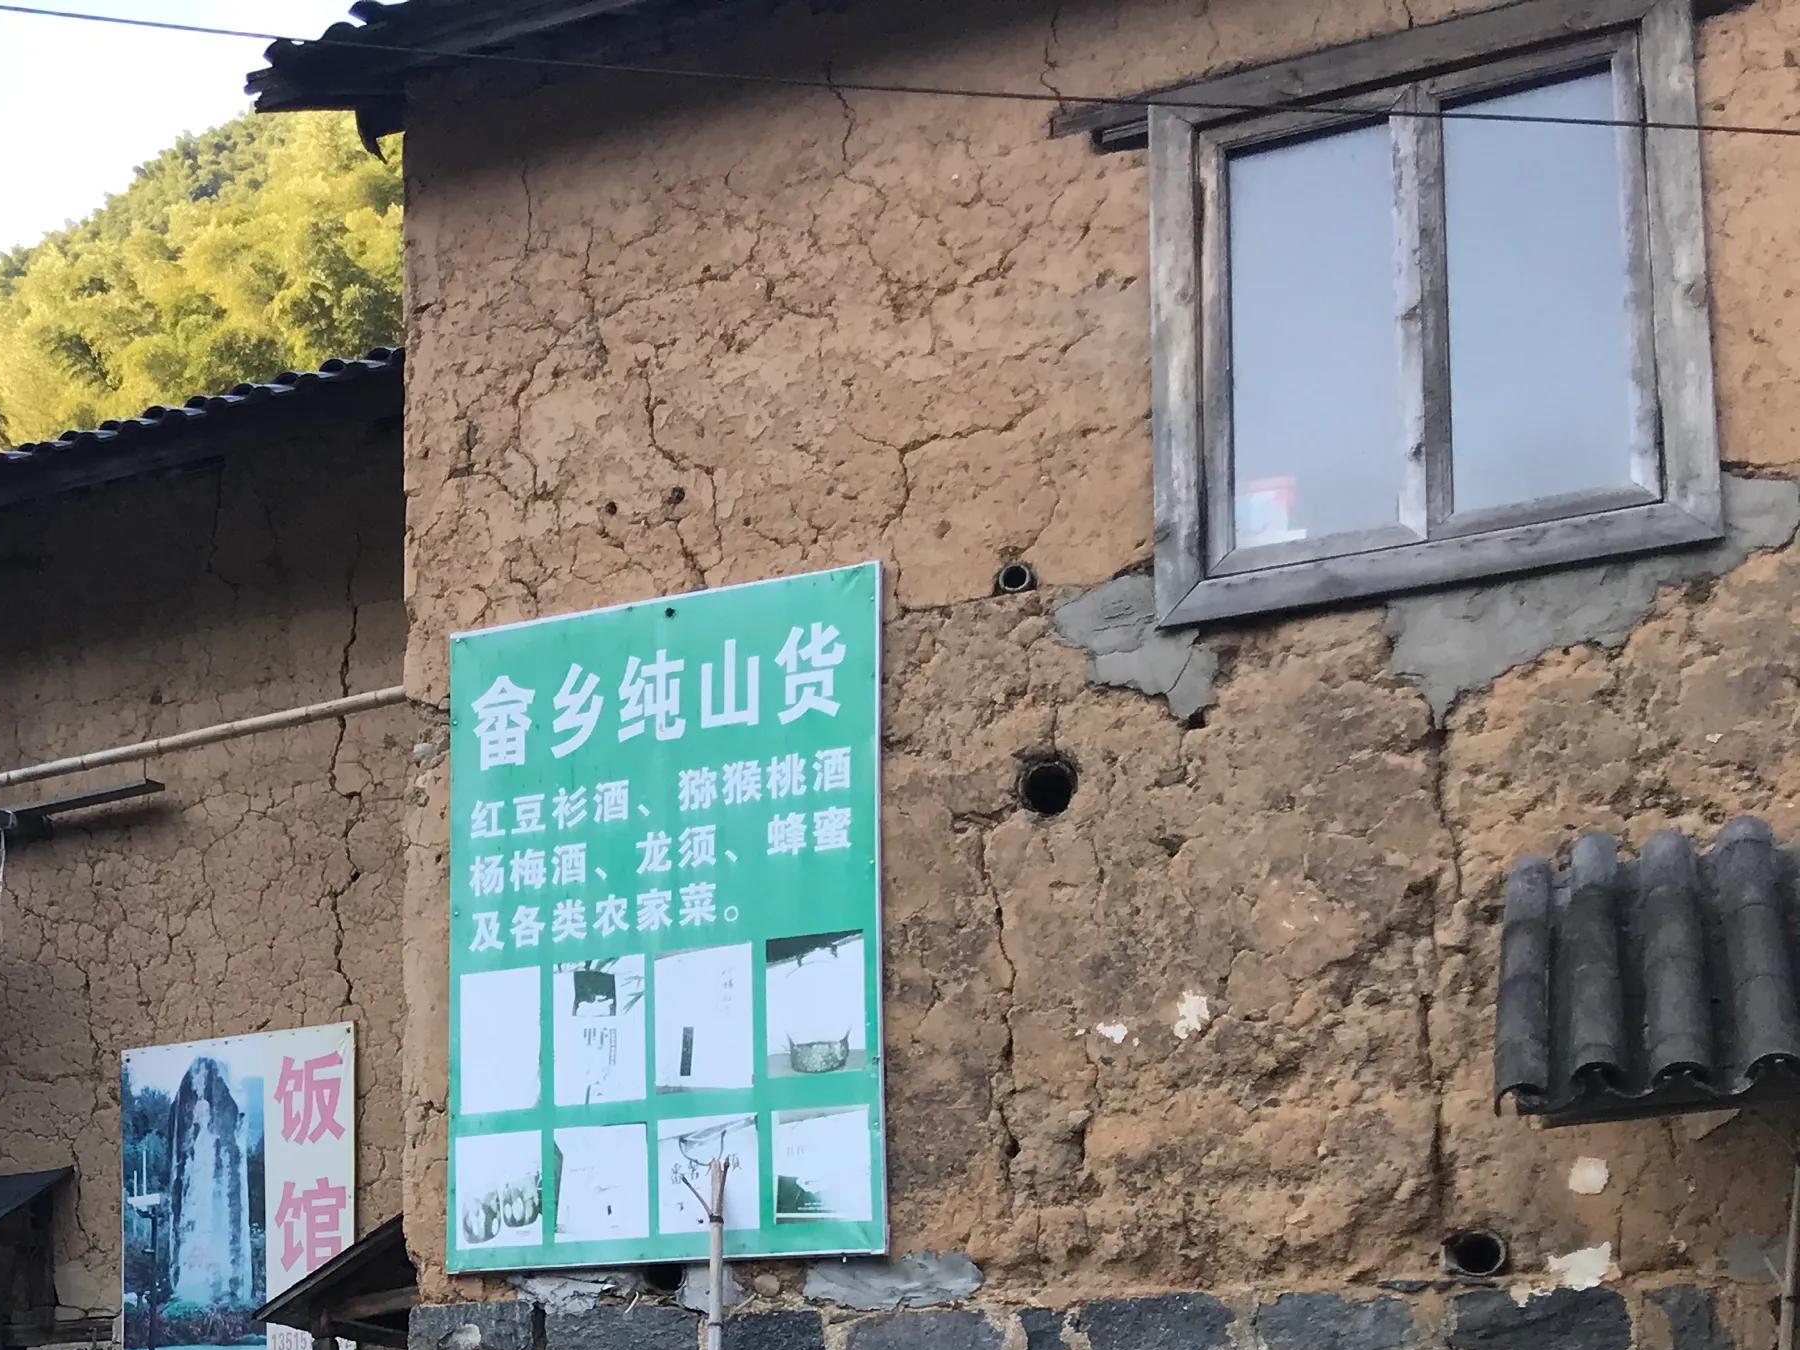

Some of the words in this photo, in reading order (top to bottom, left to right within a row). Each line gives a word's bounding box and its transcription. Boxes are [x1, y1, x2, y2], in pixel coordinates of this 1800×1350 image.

[470, 622, 846, 770] 畲乡纯山货
[273, 1050, 347, 1272] 饭馆
